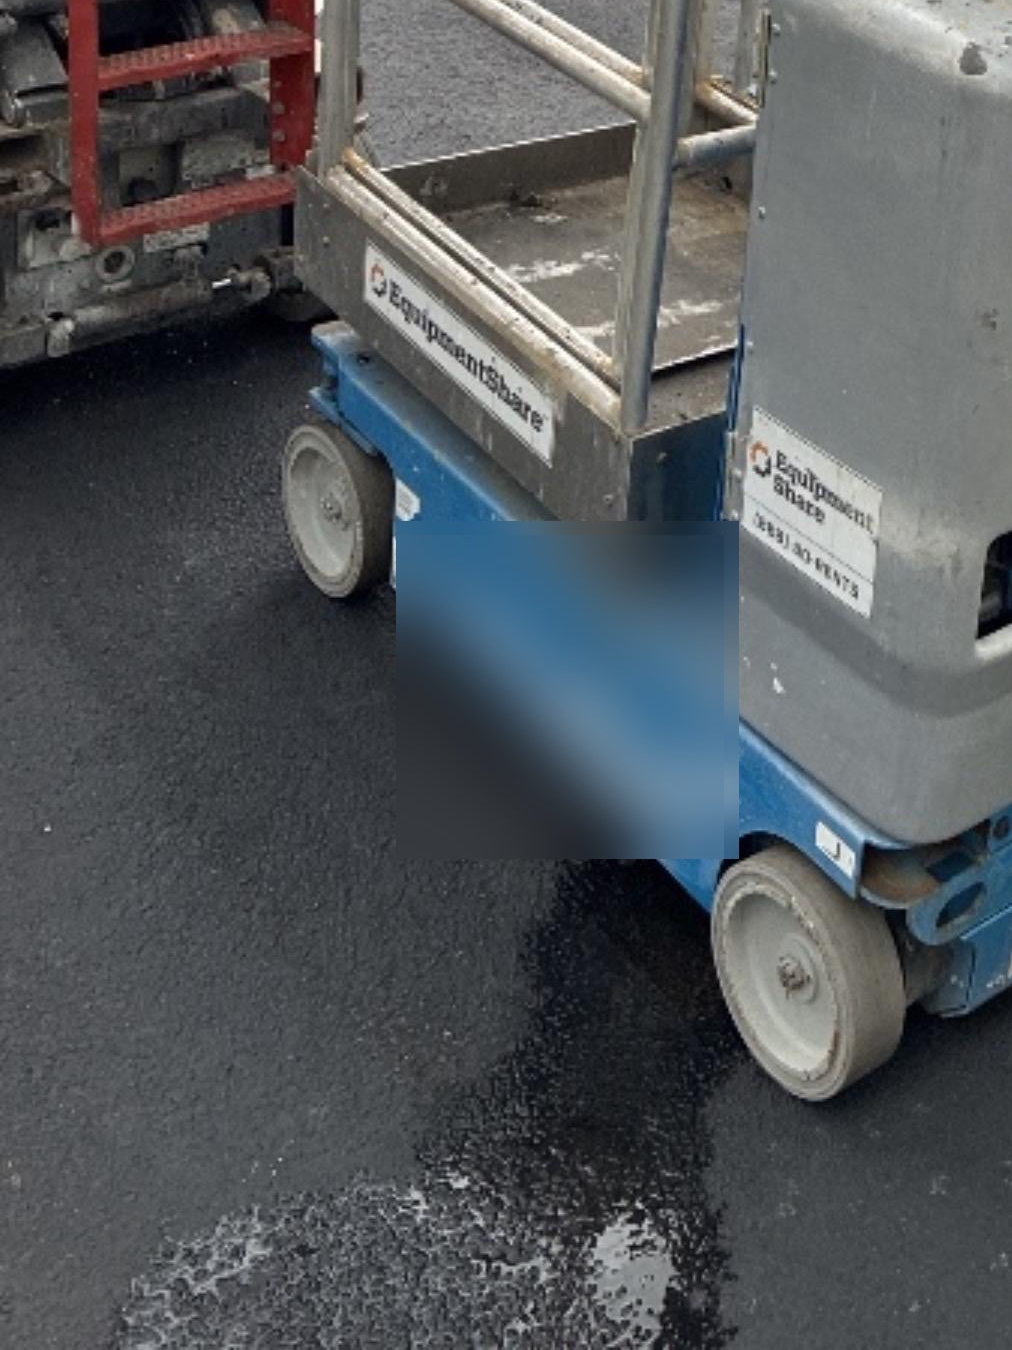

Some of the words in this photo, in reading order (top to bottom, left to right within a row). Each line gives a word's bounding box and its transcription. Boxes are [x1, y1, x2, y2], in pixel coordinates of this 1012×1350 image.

[388, 280, 546, 433] EquipmentShare
[772, 475, 826, 526] Share
[775, 449, 874, 535] Equipment
